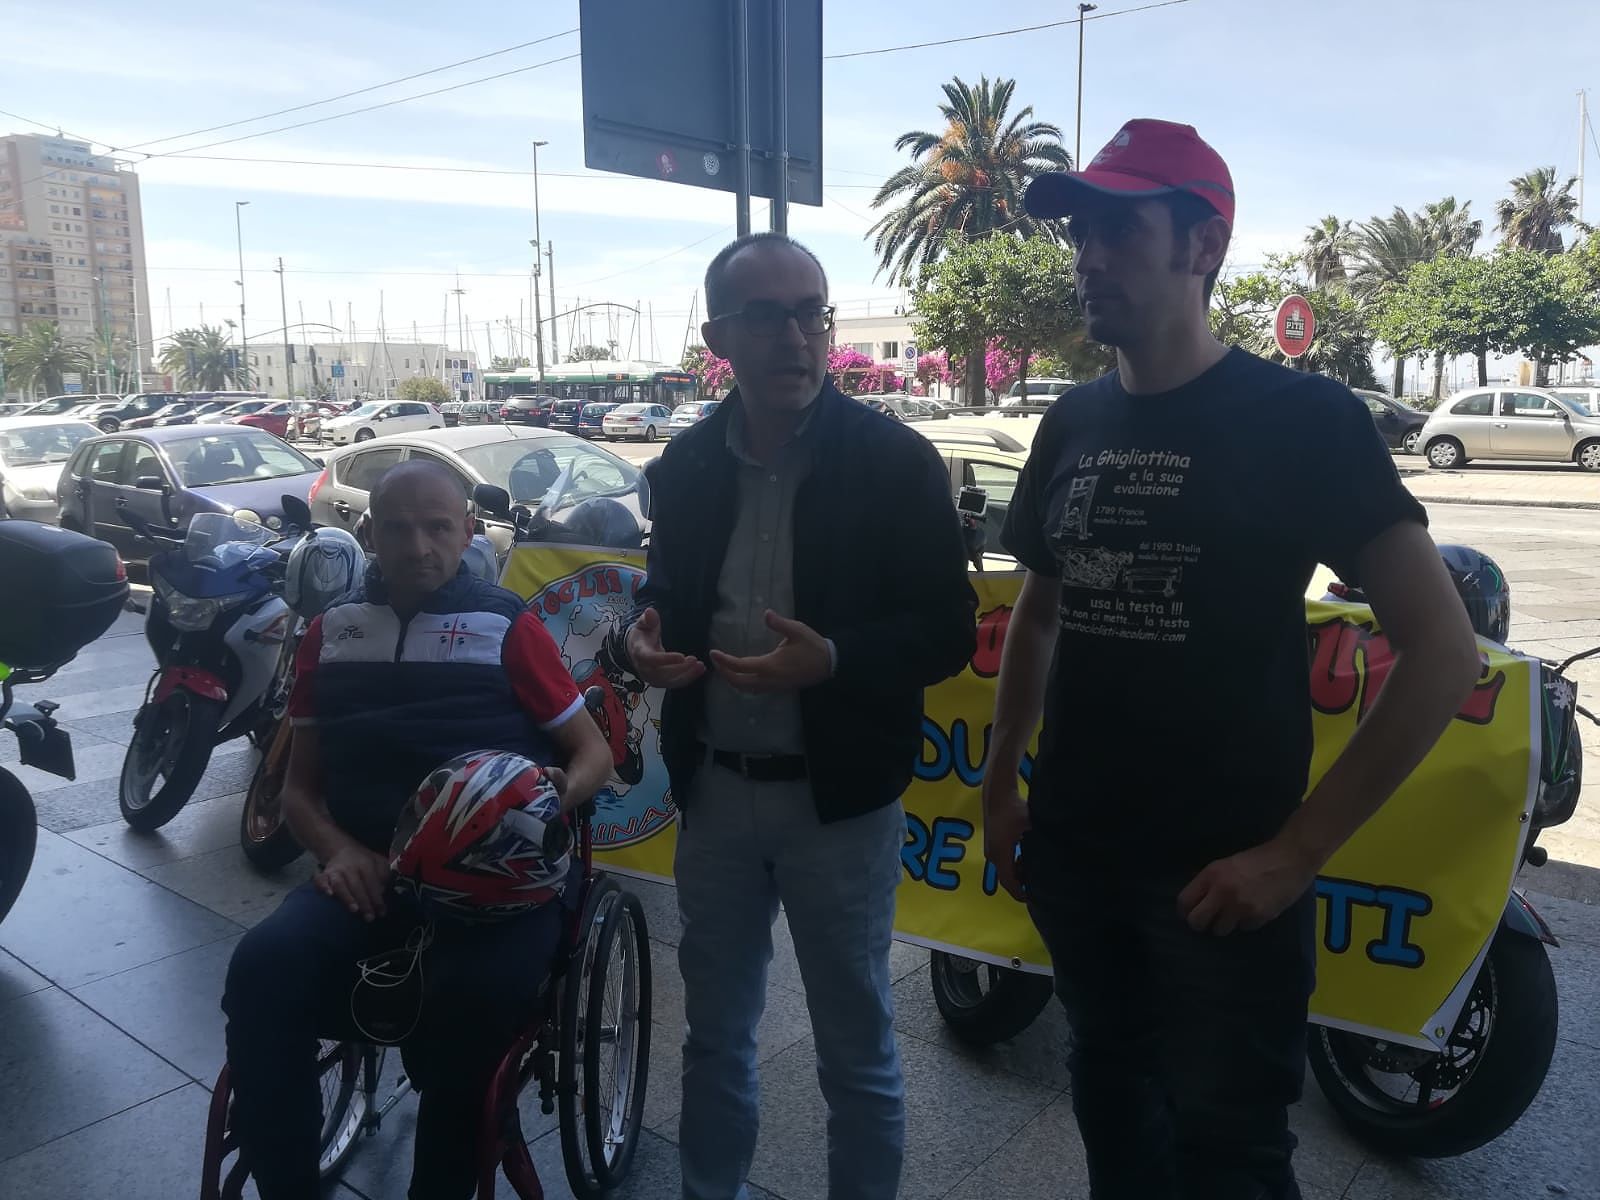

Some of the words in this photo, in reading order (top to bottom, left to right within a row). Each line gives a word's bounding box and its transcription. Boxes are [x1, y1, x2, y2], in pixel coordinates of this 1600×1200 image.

[1078, 454, 1094, 470] La
[1096, 448, 1192, 470] Ghigliottina
[1129, 472, 1137, 481] e
[1142, 468, 1155, 482] la
[1159, 472, 1185, 484] sua
[1113, 482, 1181, 496] evoluzione
[1090, 598, 1112, 610] usa
[1116, 597, 1125, 612] la
[1129, 600, 1165, 615] testa
[1073, 609, 1089, 620] non
[1144, 615, 1155, 627] la
[1160, 617, 1191, 629] testa
